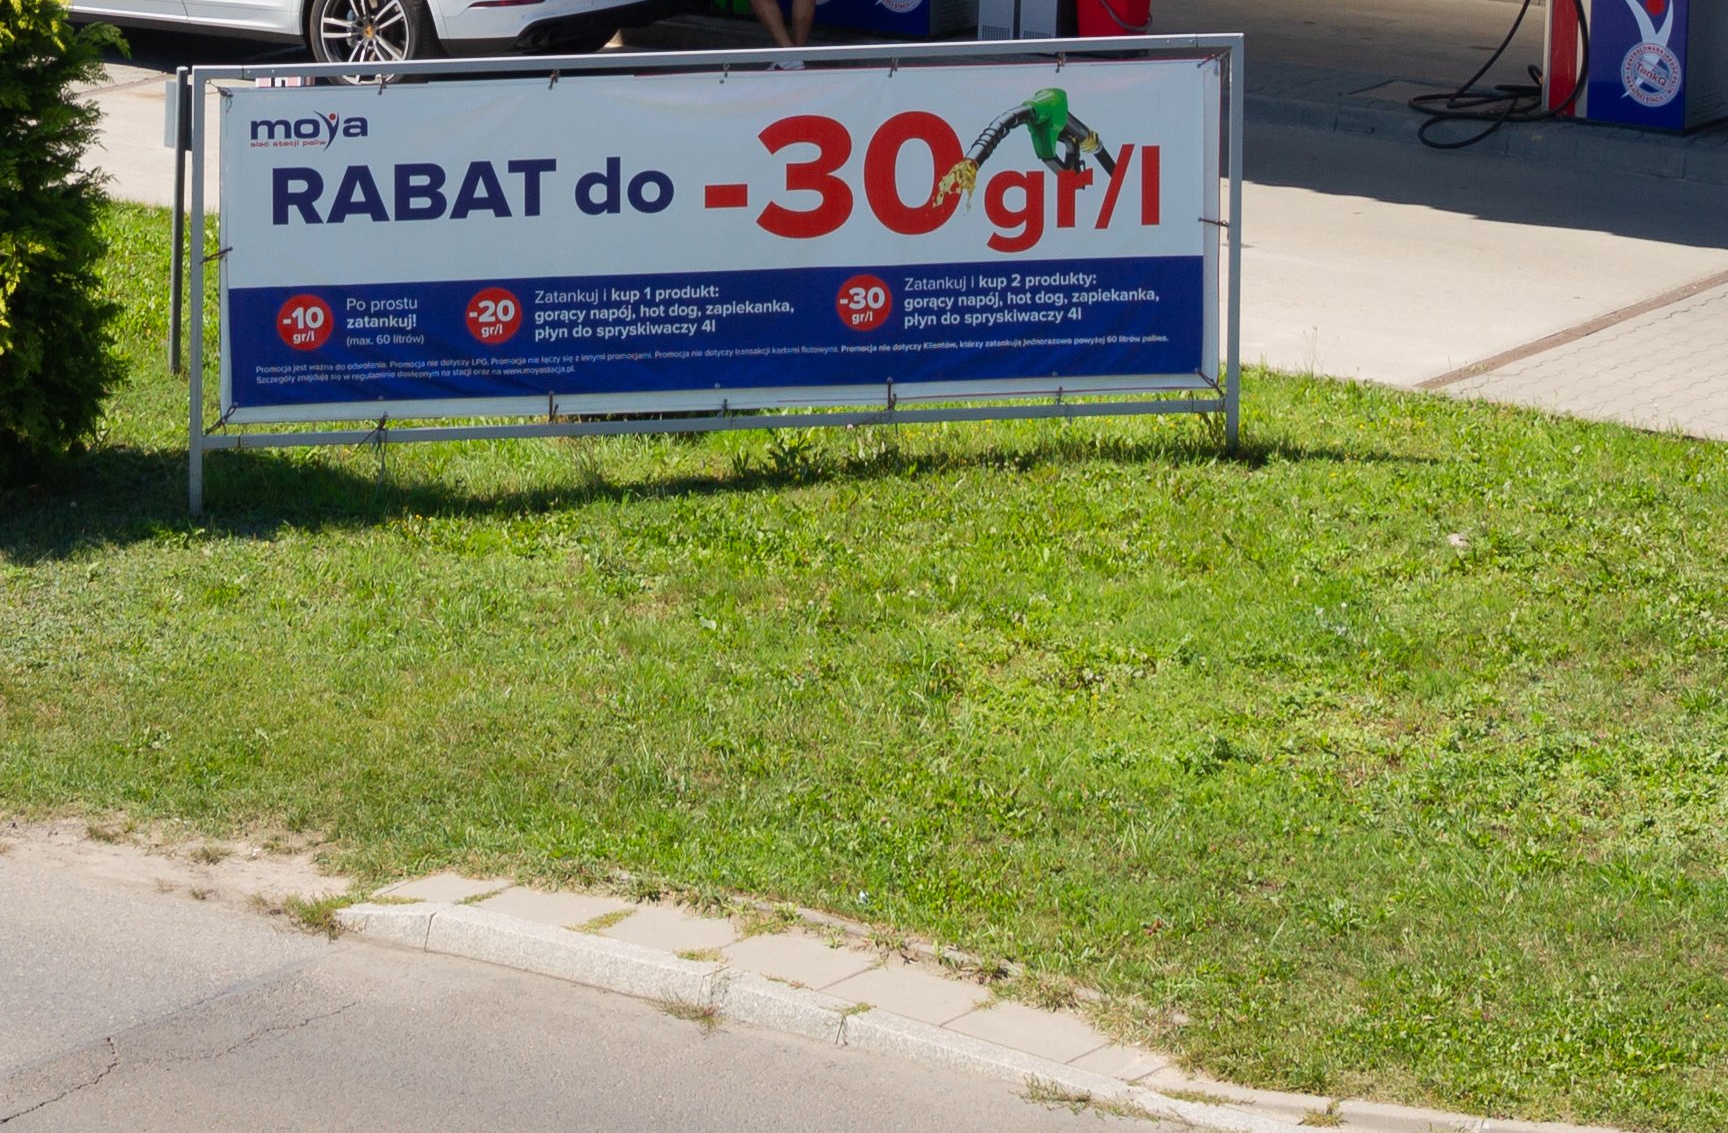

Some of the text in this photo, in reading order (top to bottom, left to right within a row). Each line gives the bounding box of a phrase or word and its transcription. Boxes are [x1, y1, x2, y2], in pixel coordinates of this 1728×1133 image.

[1635, 61, 1667, 87] TankQ
[250, 110, 368, 152] moya
[272, 110, 1162, 254] RABAT do -30 gr/l
[904, 271, 1097, 292] Zatankuj i kup 2 produkty:
[346, 296, 418, 315] Po prostu
[535, 285, 719, 306] Zatankuj i kup 1 produkt:
[839, 286, 885, 310] -30
[904, 287, 1160, 311] gorący napój, hot dog, zapiekanka,
[282, 306, 325, 330] -10
[468, 299, 516, 324] -20
[535, 299, 794, 324] gorący napój, hot dog, zapiekanka,
[852, 311, 873, 325] gr/l
[904, 312, 937, 329] płyn
[940, 311, 960, 325] do
[964, 309, 1064, 328] spryskiwaczy
[346, 313, 417, 333] zatankuj!
[481, 323, 503, 338] gr/l
[535, 324, 569, 343] płyn
[572, 323, 592, 338] do
[596, 321, 697, 340] spryskiwaczy
[293, 331, 315, 345] gr/l
[346, 331, 424, 347] (max. 60 litrów)
